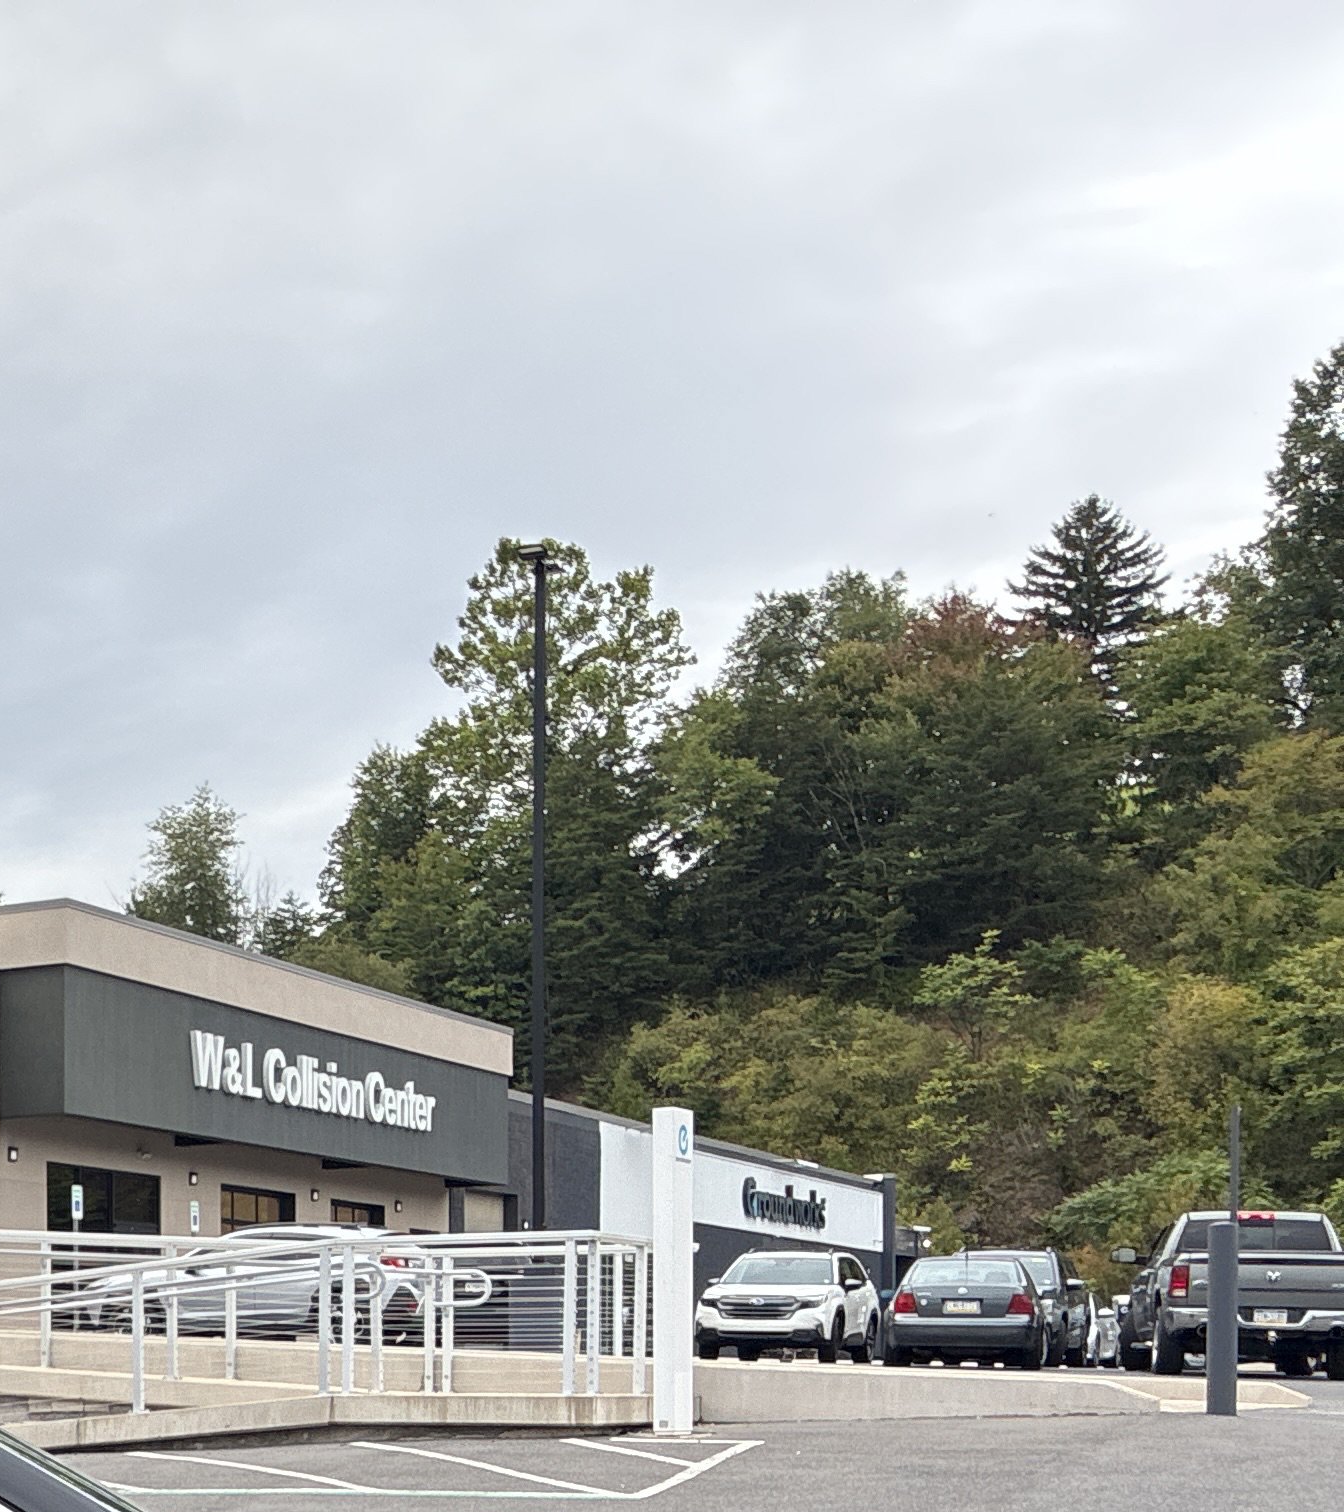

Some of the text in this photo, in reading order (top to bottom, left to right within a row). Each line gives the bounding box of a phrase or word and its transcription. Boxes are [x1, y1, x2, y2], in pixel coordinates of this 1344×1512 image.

[190, 1029, 436, 1132] W&L Collision Center
